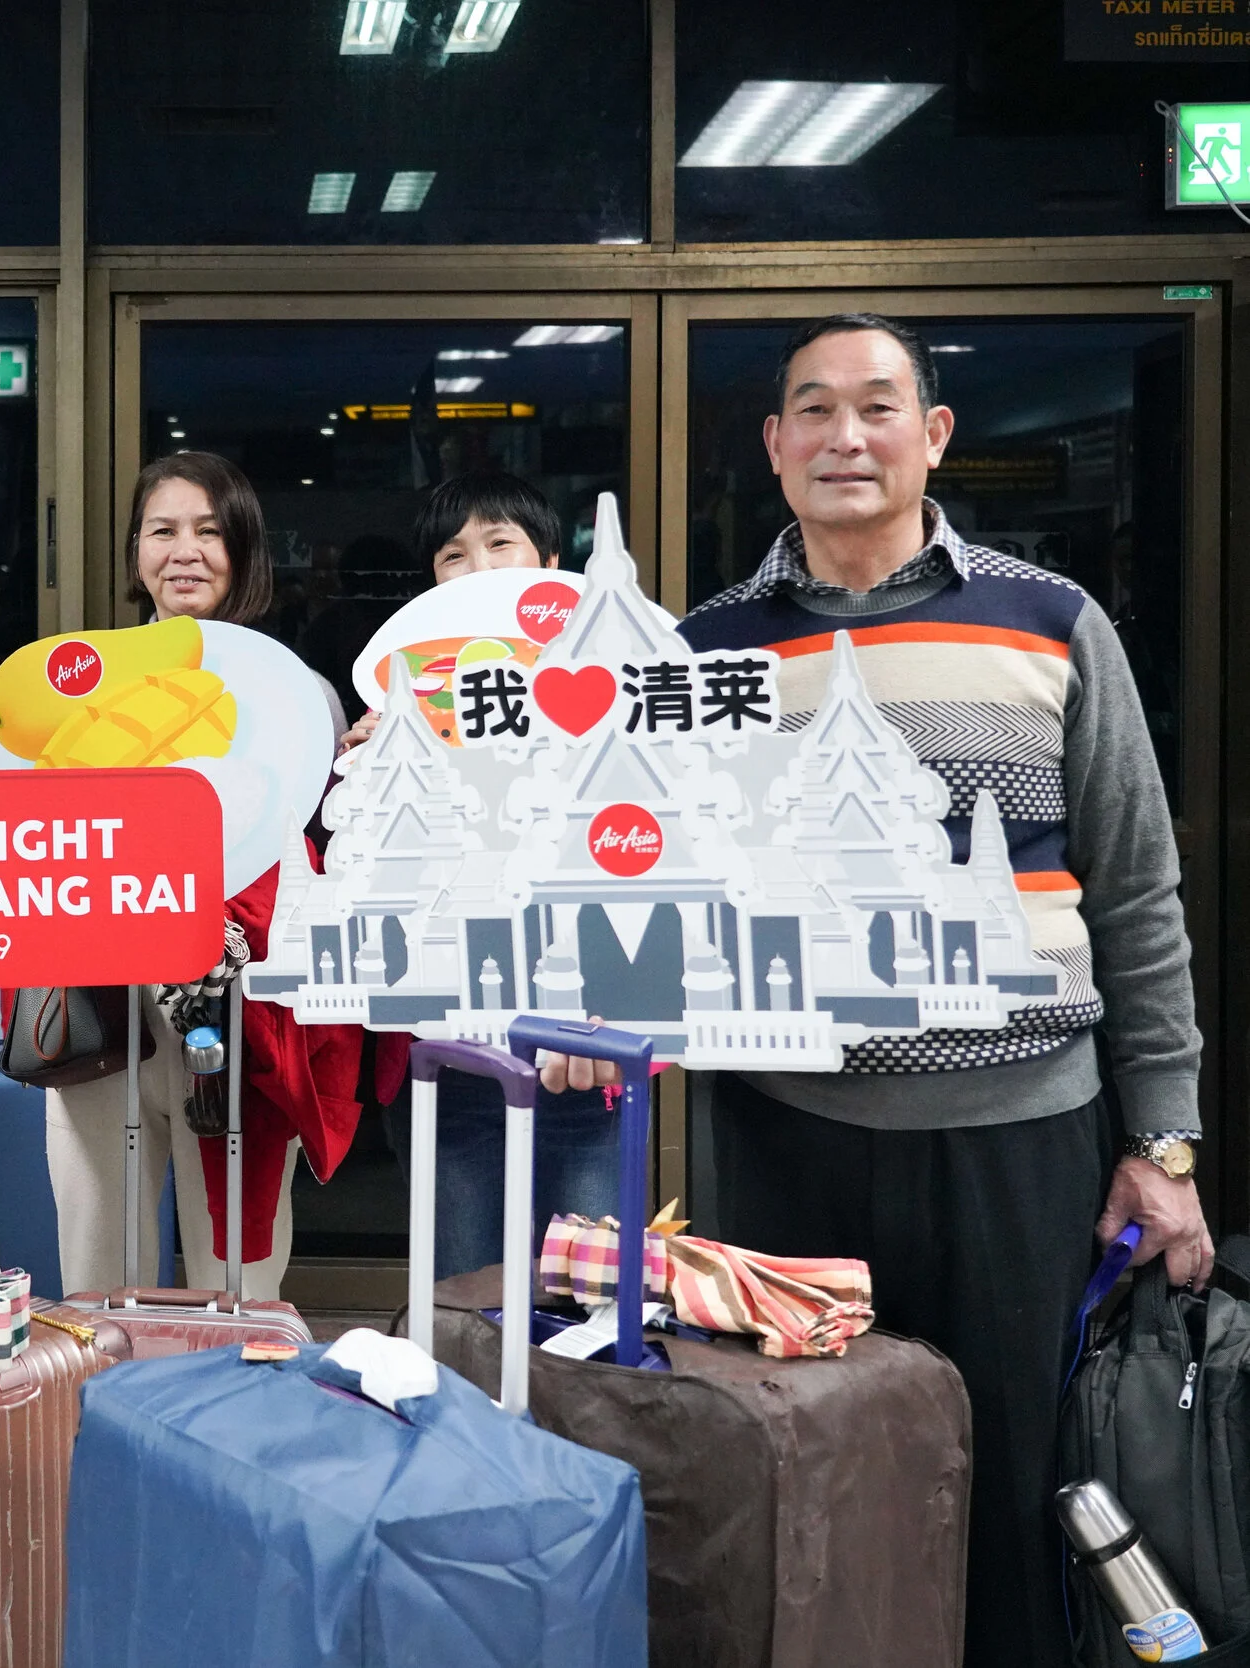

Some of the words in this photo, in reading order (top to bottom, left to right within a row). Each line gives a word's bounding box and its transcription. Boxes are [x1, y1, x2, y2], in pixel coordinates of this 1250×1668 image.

[1103, 0, 1151, 14] TAXI
[1162, 0, 1235, 14] METER
[459, 667, 531, 739] 我
[622, 657, 772, 734] 清莱
[110, 873, 196, 914] RAI
